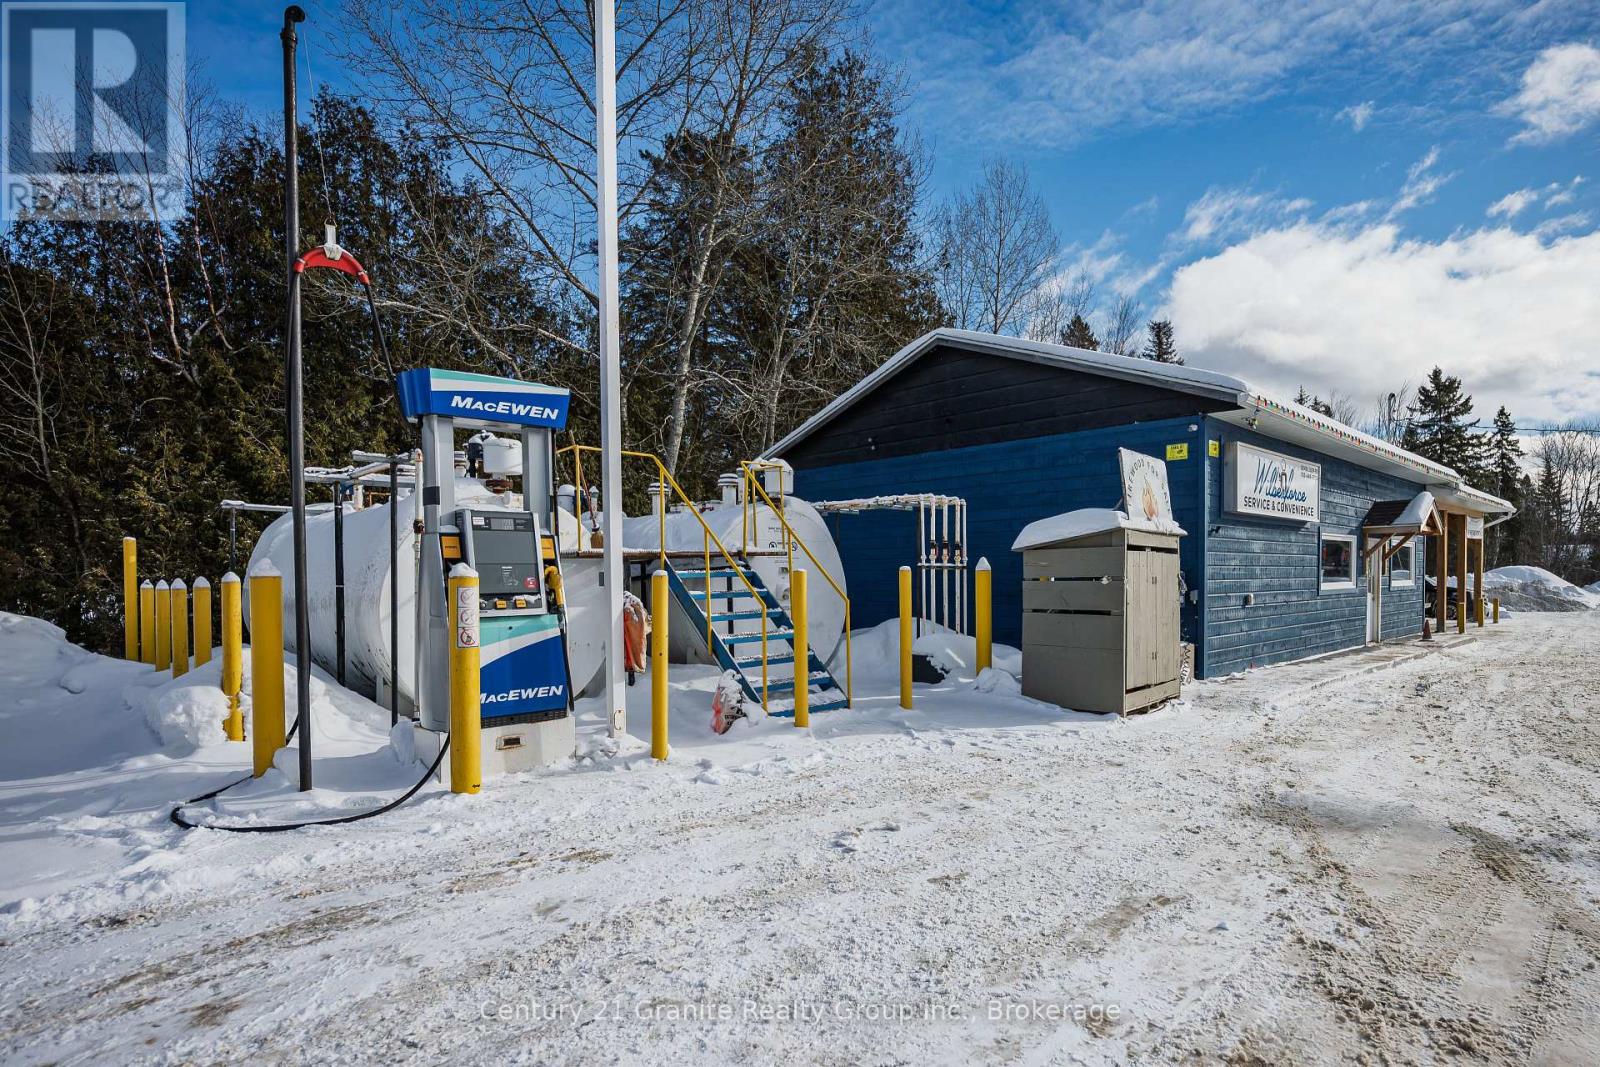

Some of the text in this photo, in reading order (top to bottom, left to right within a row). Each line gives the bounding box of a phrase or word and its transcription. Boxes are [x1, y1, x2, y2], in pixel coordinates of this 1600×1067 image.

[1254, 458, 1307, 502] Wilberforce
[1243, 496, 1314, 517] SERVICE & CONVENIENCE
